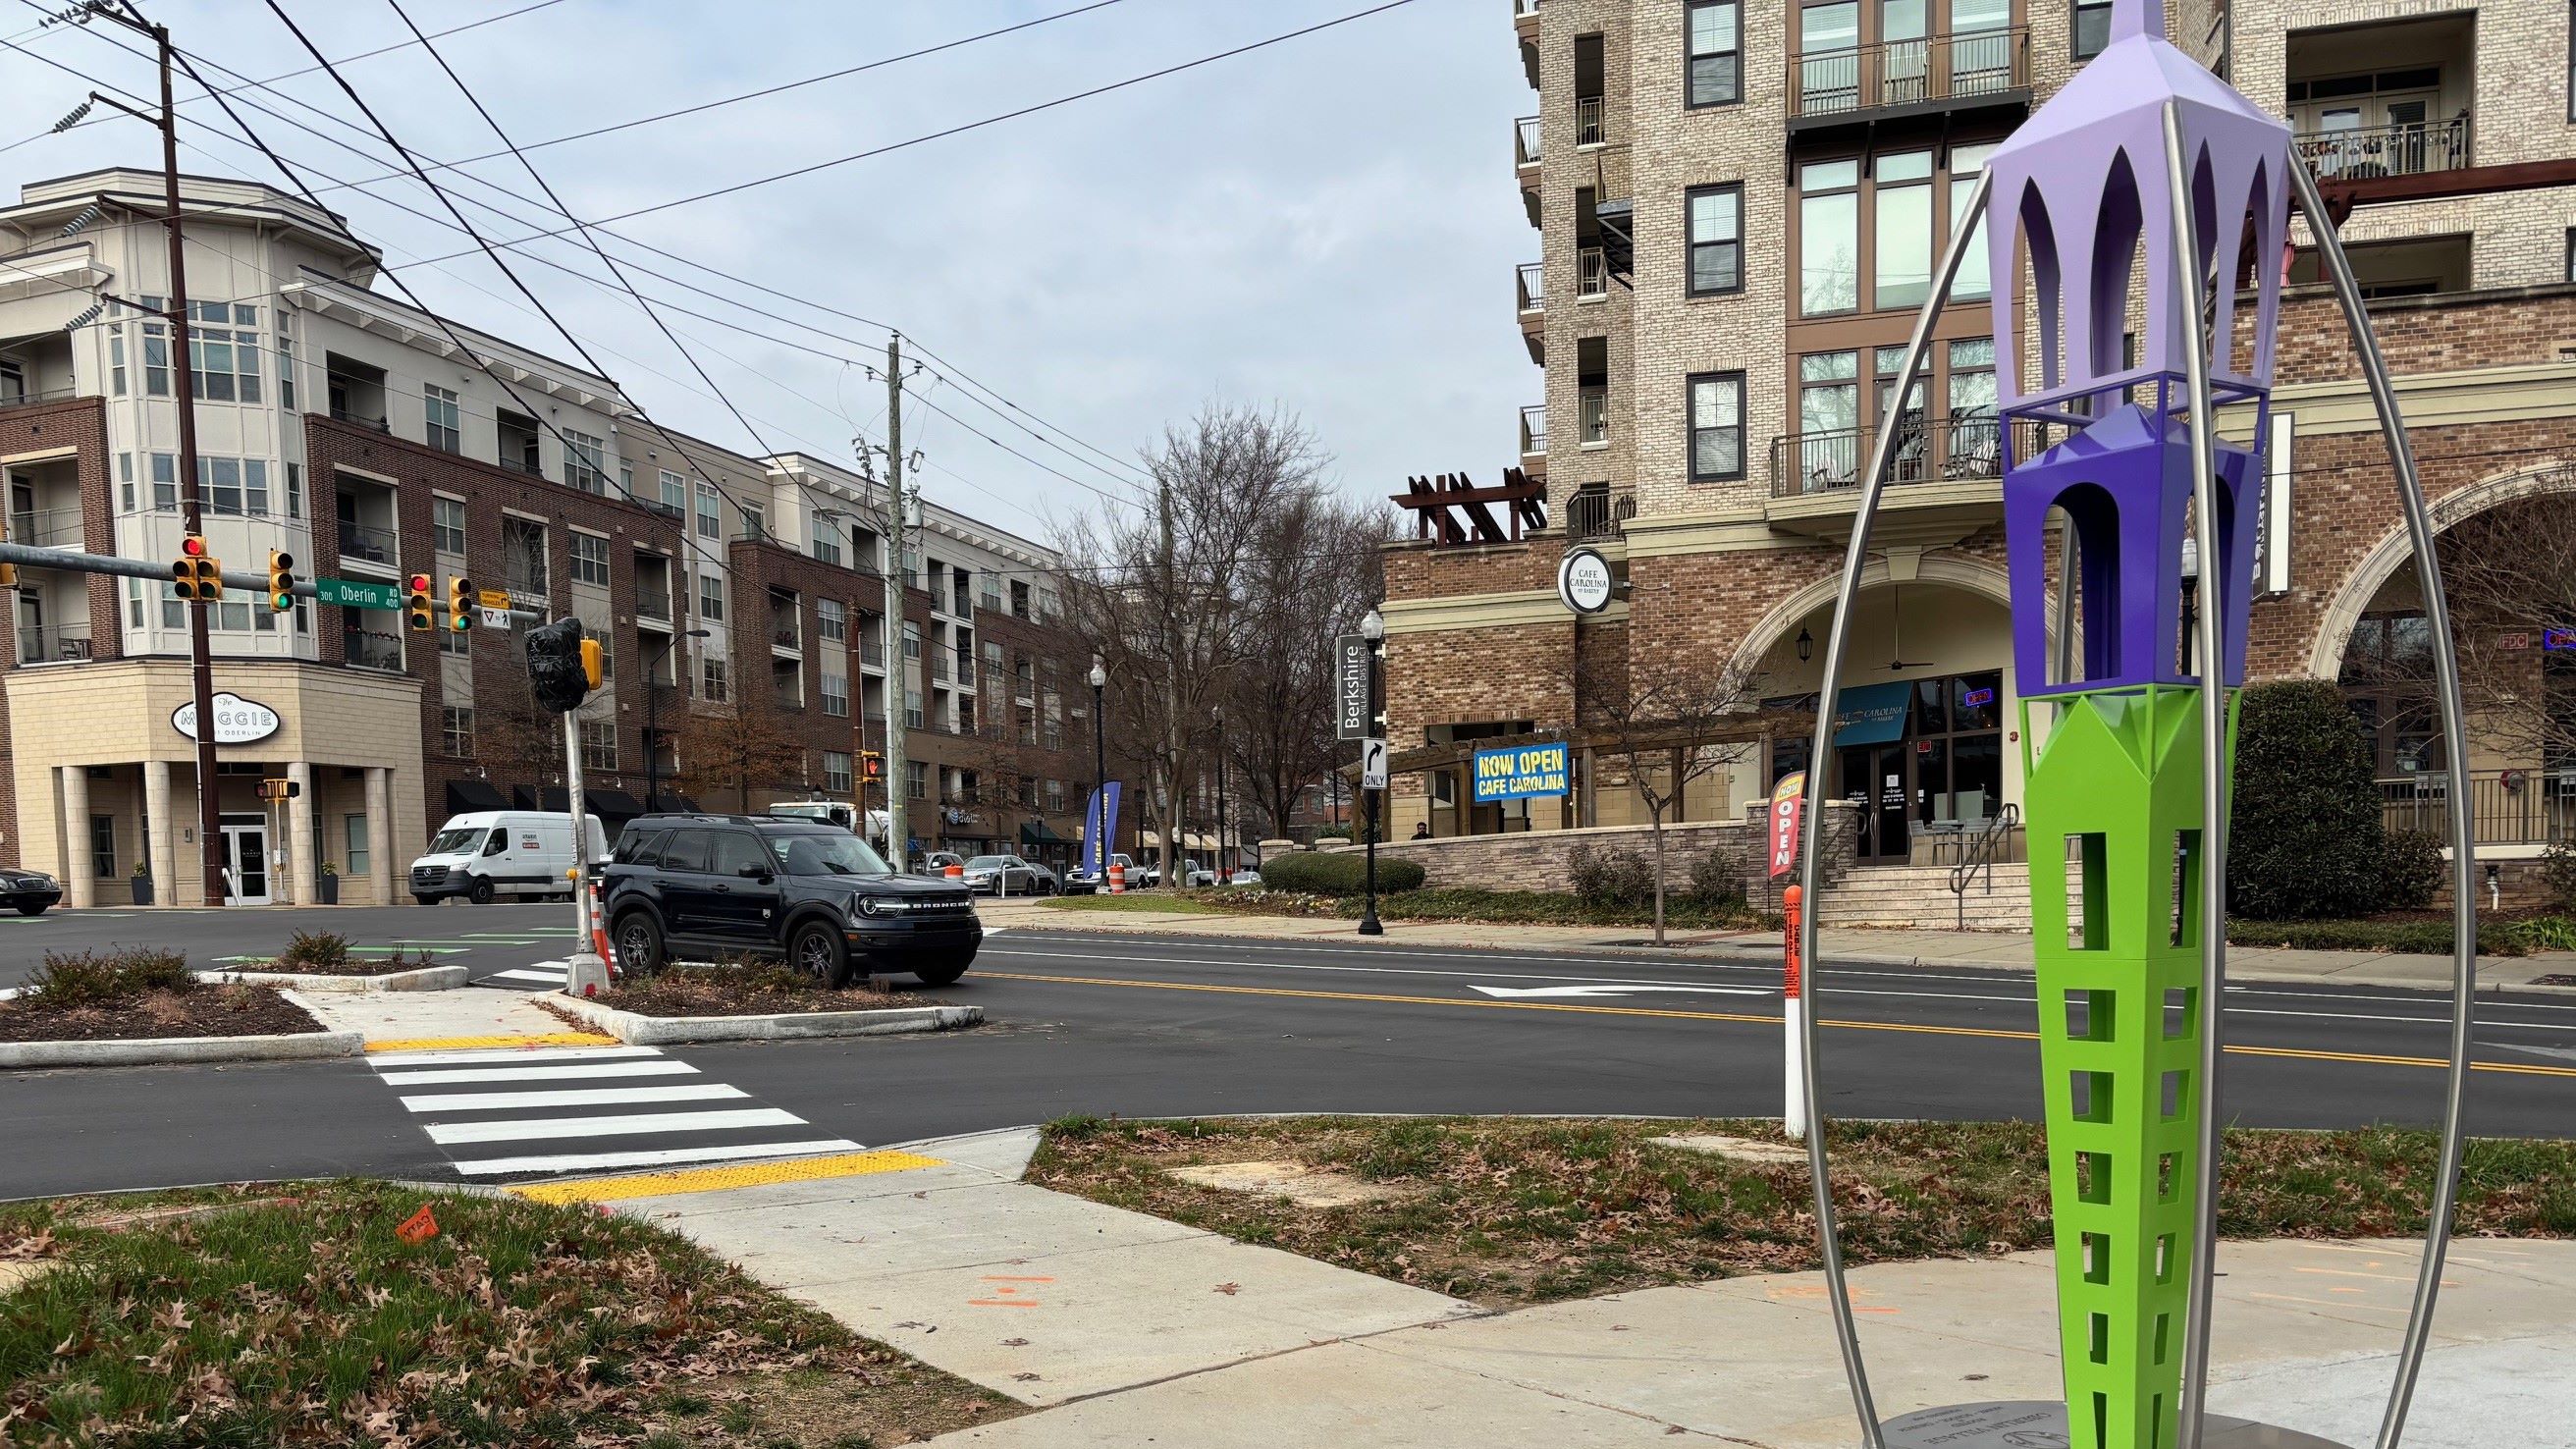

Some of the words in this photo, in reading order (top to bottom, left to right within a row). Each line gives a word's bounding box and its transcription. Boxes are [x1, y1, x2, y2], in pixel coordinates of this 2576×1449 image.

[1579, 569, 1598, 578] CAFE
[1570, 578, 1607, 588] CAROLINA
[320, 591, 333, 601] 300
[341, 585, 377, 604] Oberlin
[389, 588, 398, 598] RD
[386, 598, 399, 608] 400
[2501, 635, 2525, 648] FDC
[1343, 645, 1360, 728] Berkshire
[181, 711, 272, 725] MGGIE
[1864, 706, 1903, 718] CAROLINA
[1478, 754, 1515, 778] NOW
[1520, 749, 1563, 775] OPEN
[1365, 775, 1385, 786] ONLY
[1478, 778, 1506, 796] CAFE
[1509, 774, 1566, 793] CAROLINA
[1780, 781, 1799, 798] NOW
[1775, 800, 1794, 866] OPEN
